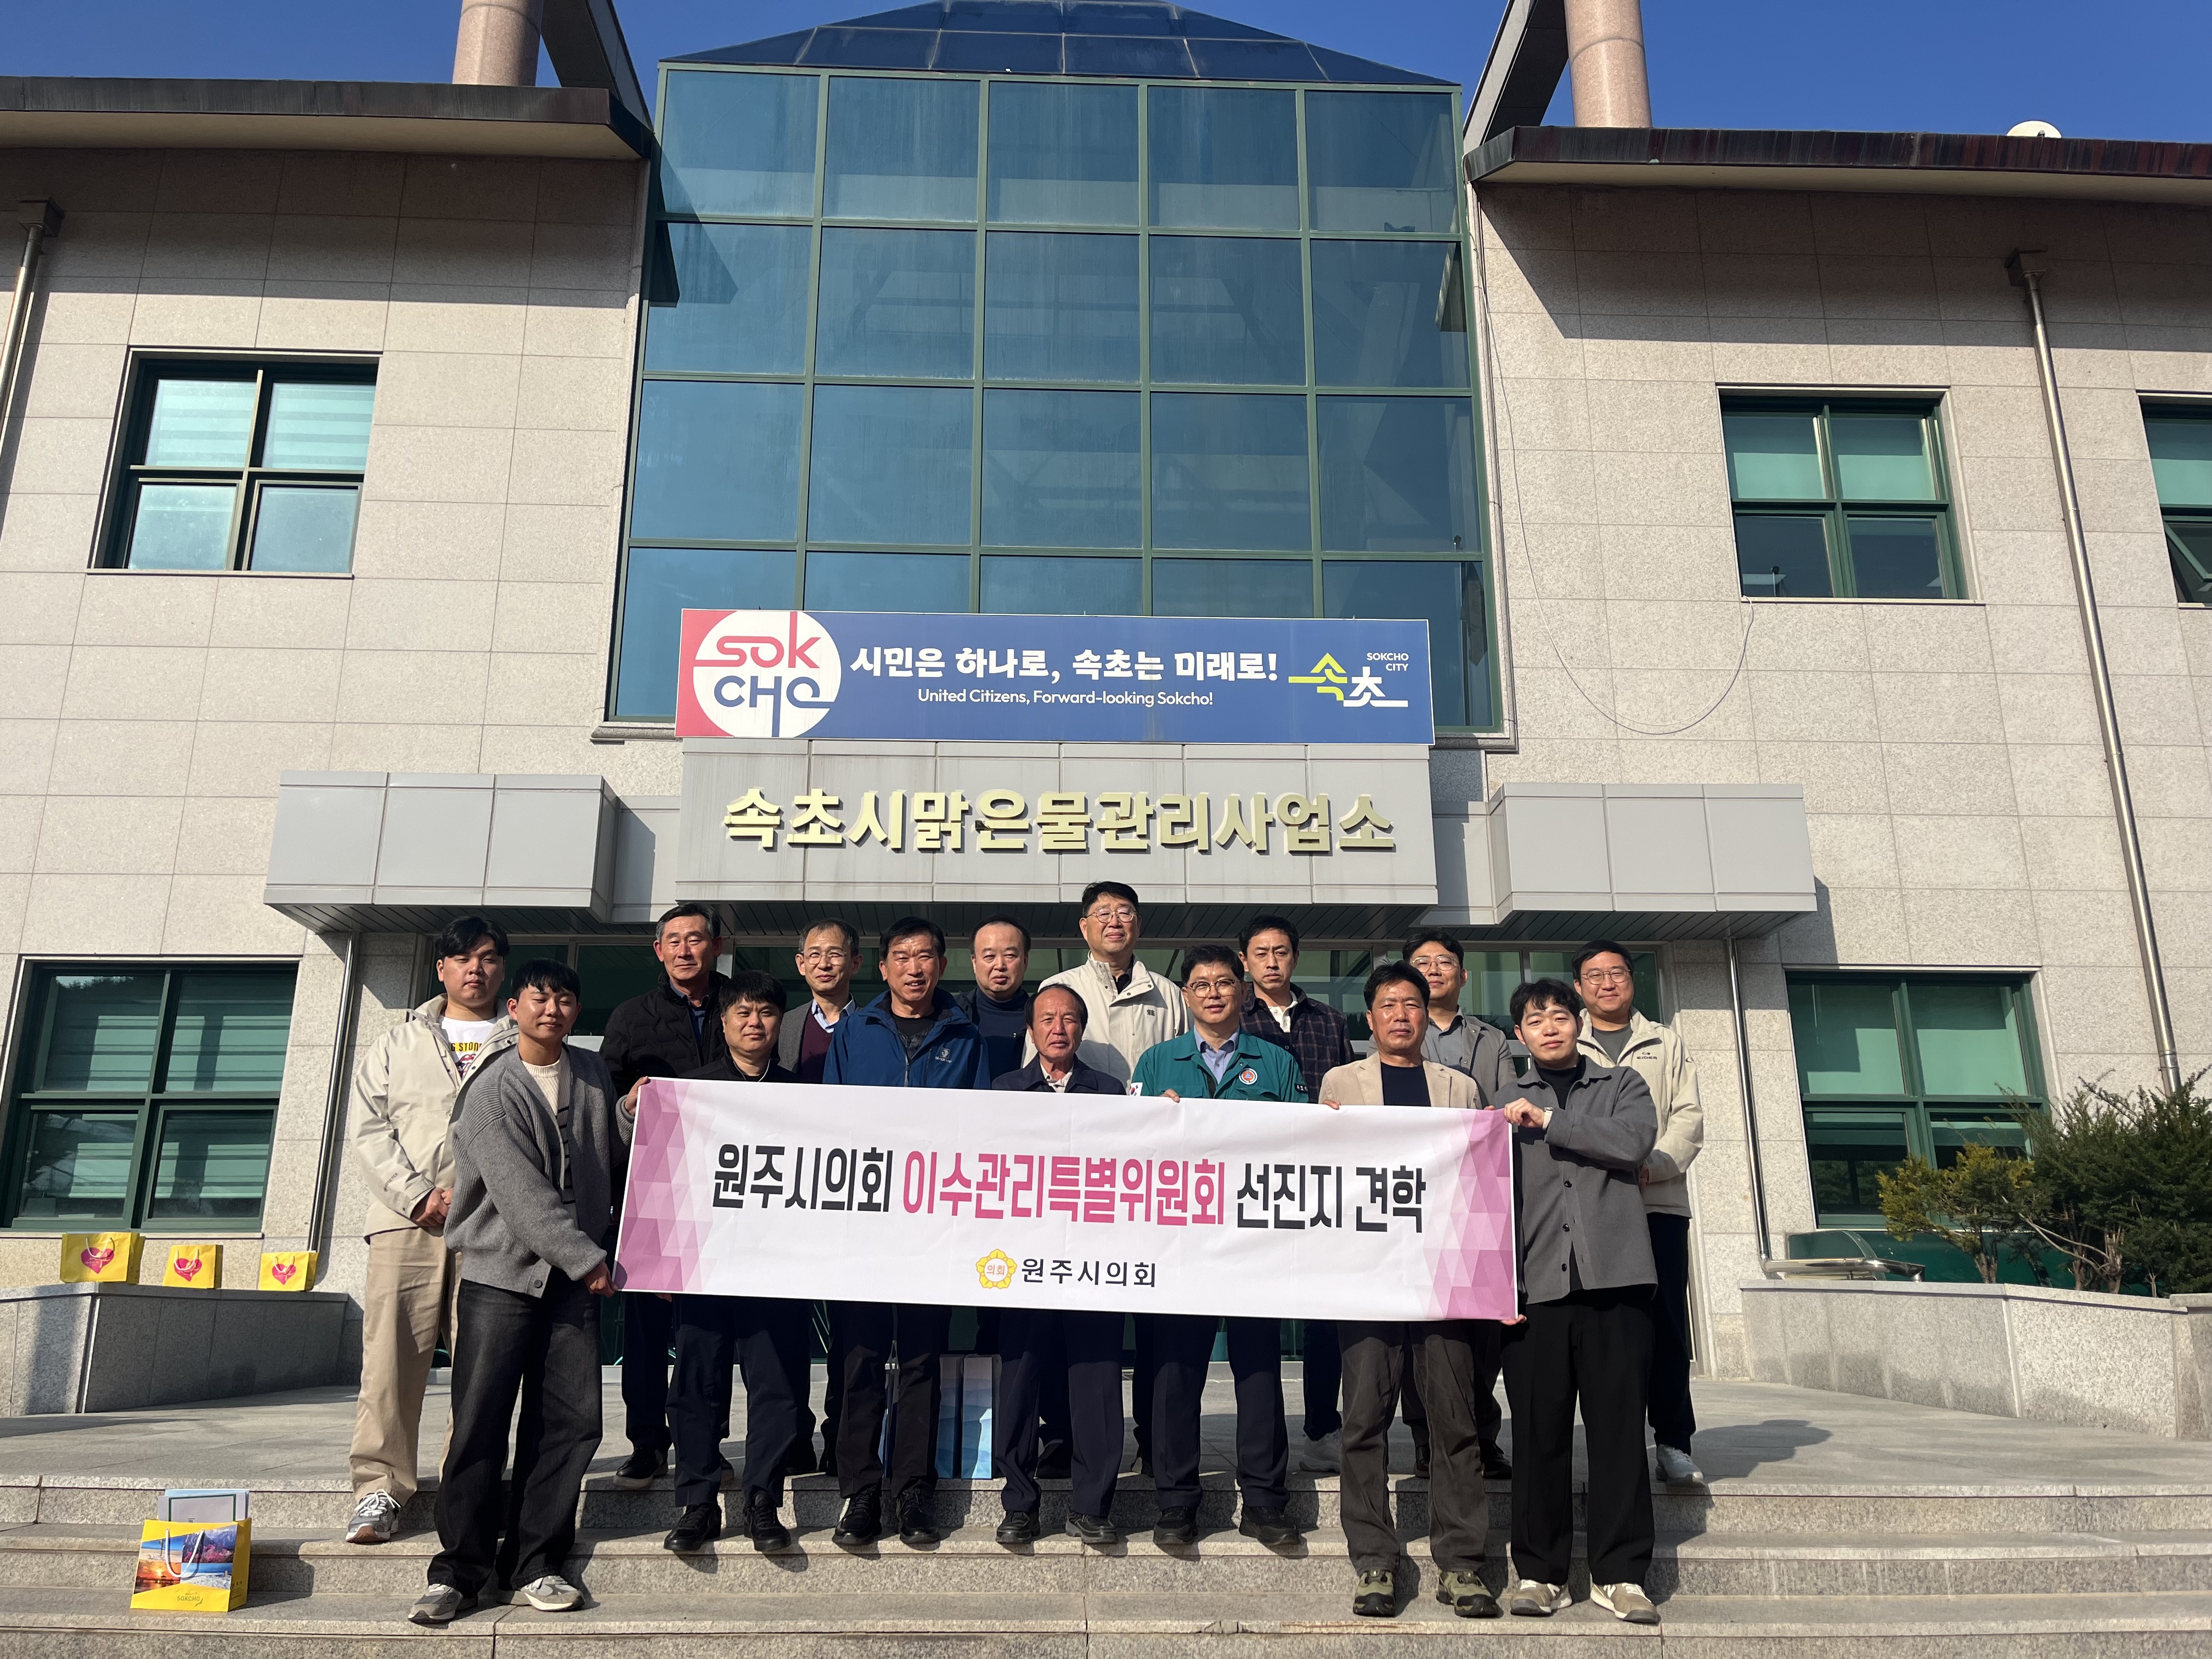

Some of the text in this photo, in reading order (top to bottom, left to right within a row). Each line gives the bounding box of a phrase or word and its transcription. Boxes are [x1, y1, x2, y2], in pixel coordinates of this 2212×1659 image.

[850, 646, 1278, 684] 시민은 하나로, 속초는 미래로!
[1367, 652, 1409, 661] SOKCHO
[1385, 663, 1409, 672] CITY
[1288, 652, 1408, 707] 속초
[918, 689, 1213, 707] United Citizens, Forward-looking Sokcho!
[724, 788, 1395, 853] 속초시맑은물관리사업소
[459, 1042, 482, 1051] STON
[712, 1143, 1426, 1233] 원주시의회 이수관리특별위원회 선진지 견학
[986, 1264, 1005, 1276] 의회
[1022, 1258, 1156, 1287] 원주시의회
